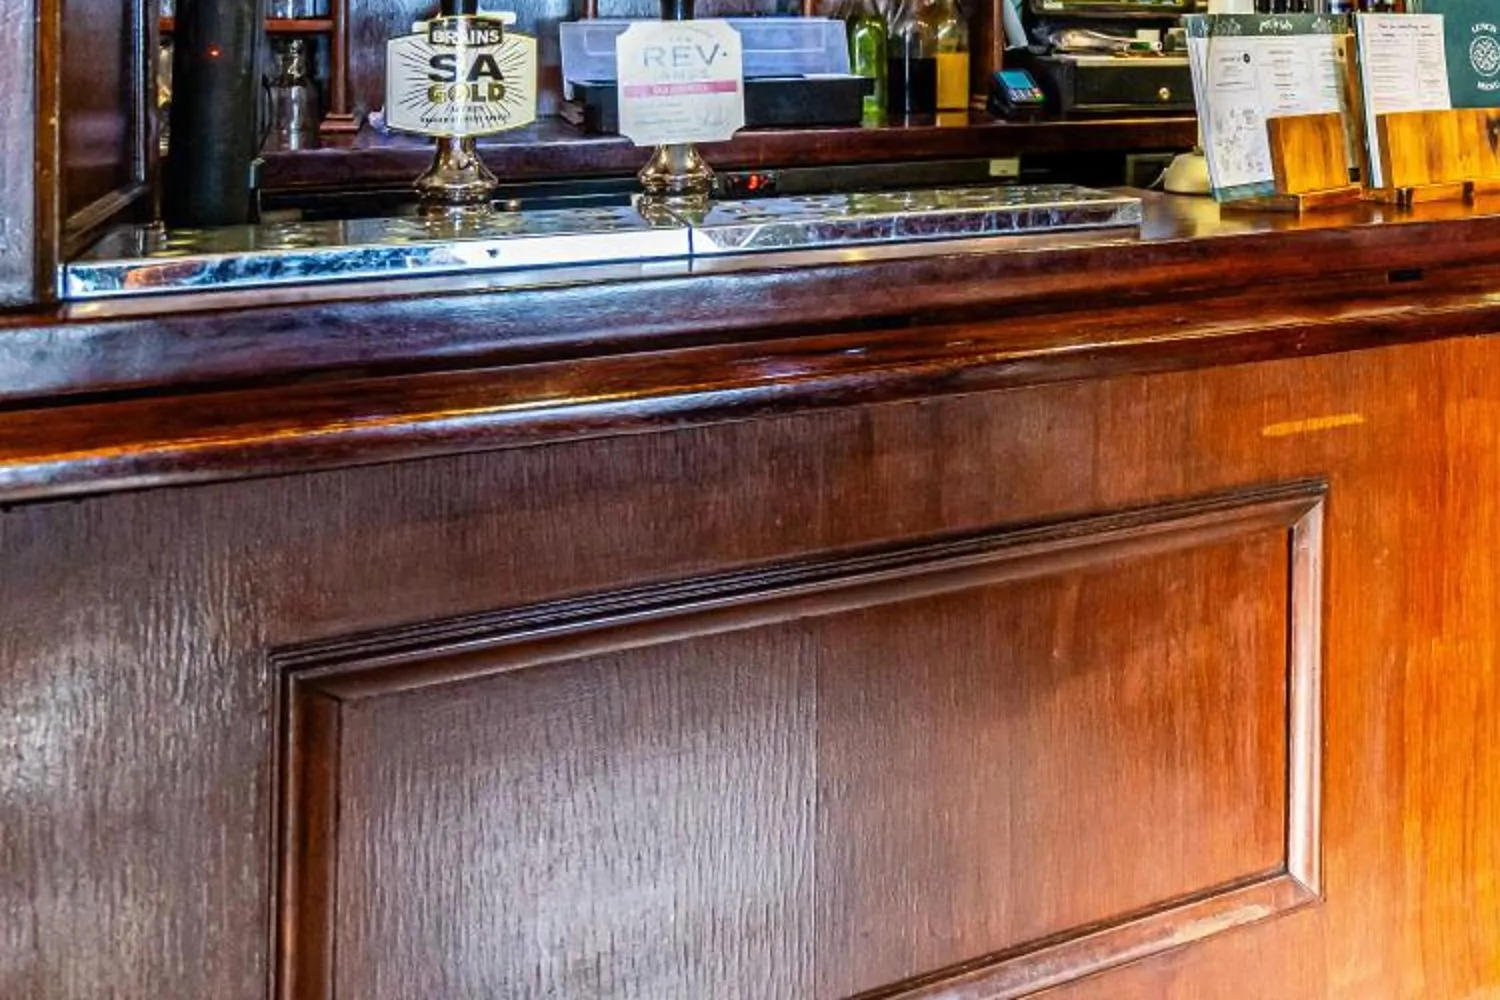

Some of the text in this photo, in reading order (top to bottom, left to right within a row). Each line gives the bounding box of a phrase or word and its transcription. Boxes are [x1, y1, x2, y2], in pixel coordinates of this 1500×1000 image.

[432, 28, 499, 44] BRAINS
[428, 53, 504, 83] SA
[427, 83, 506, 104] GOLD
